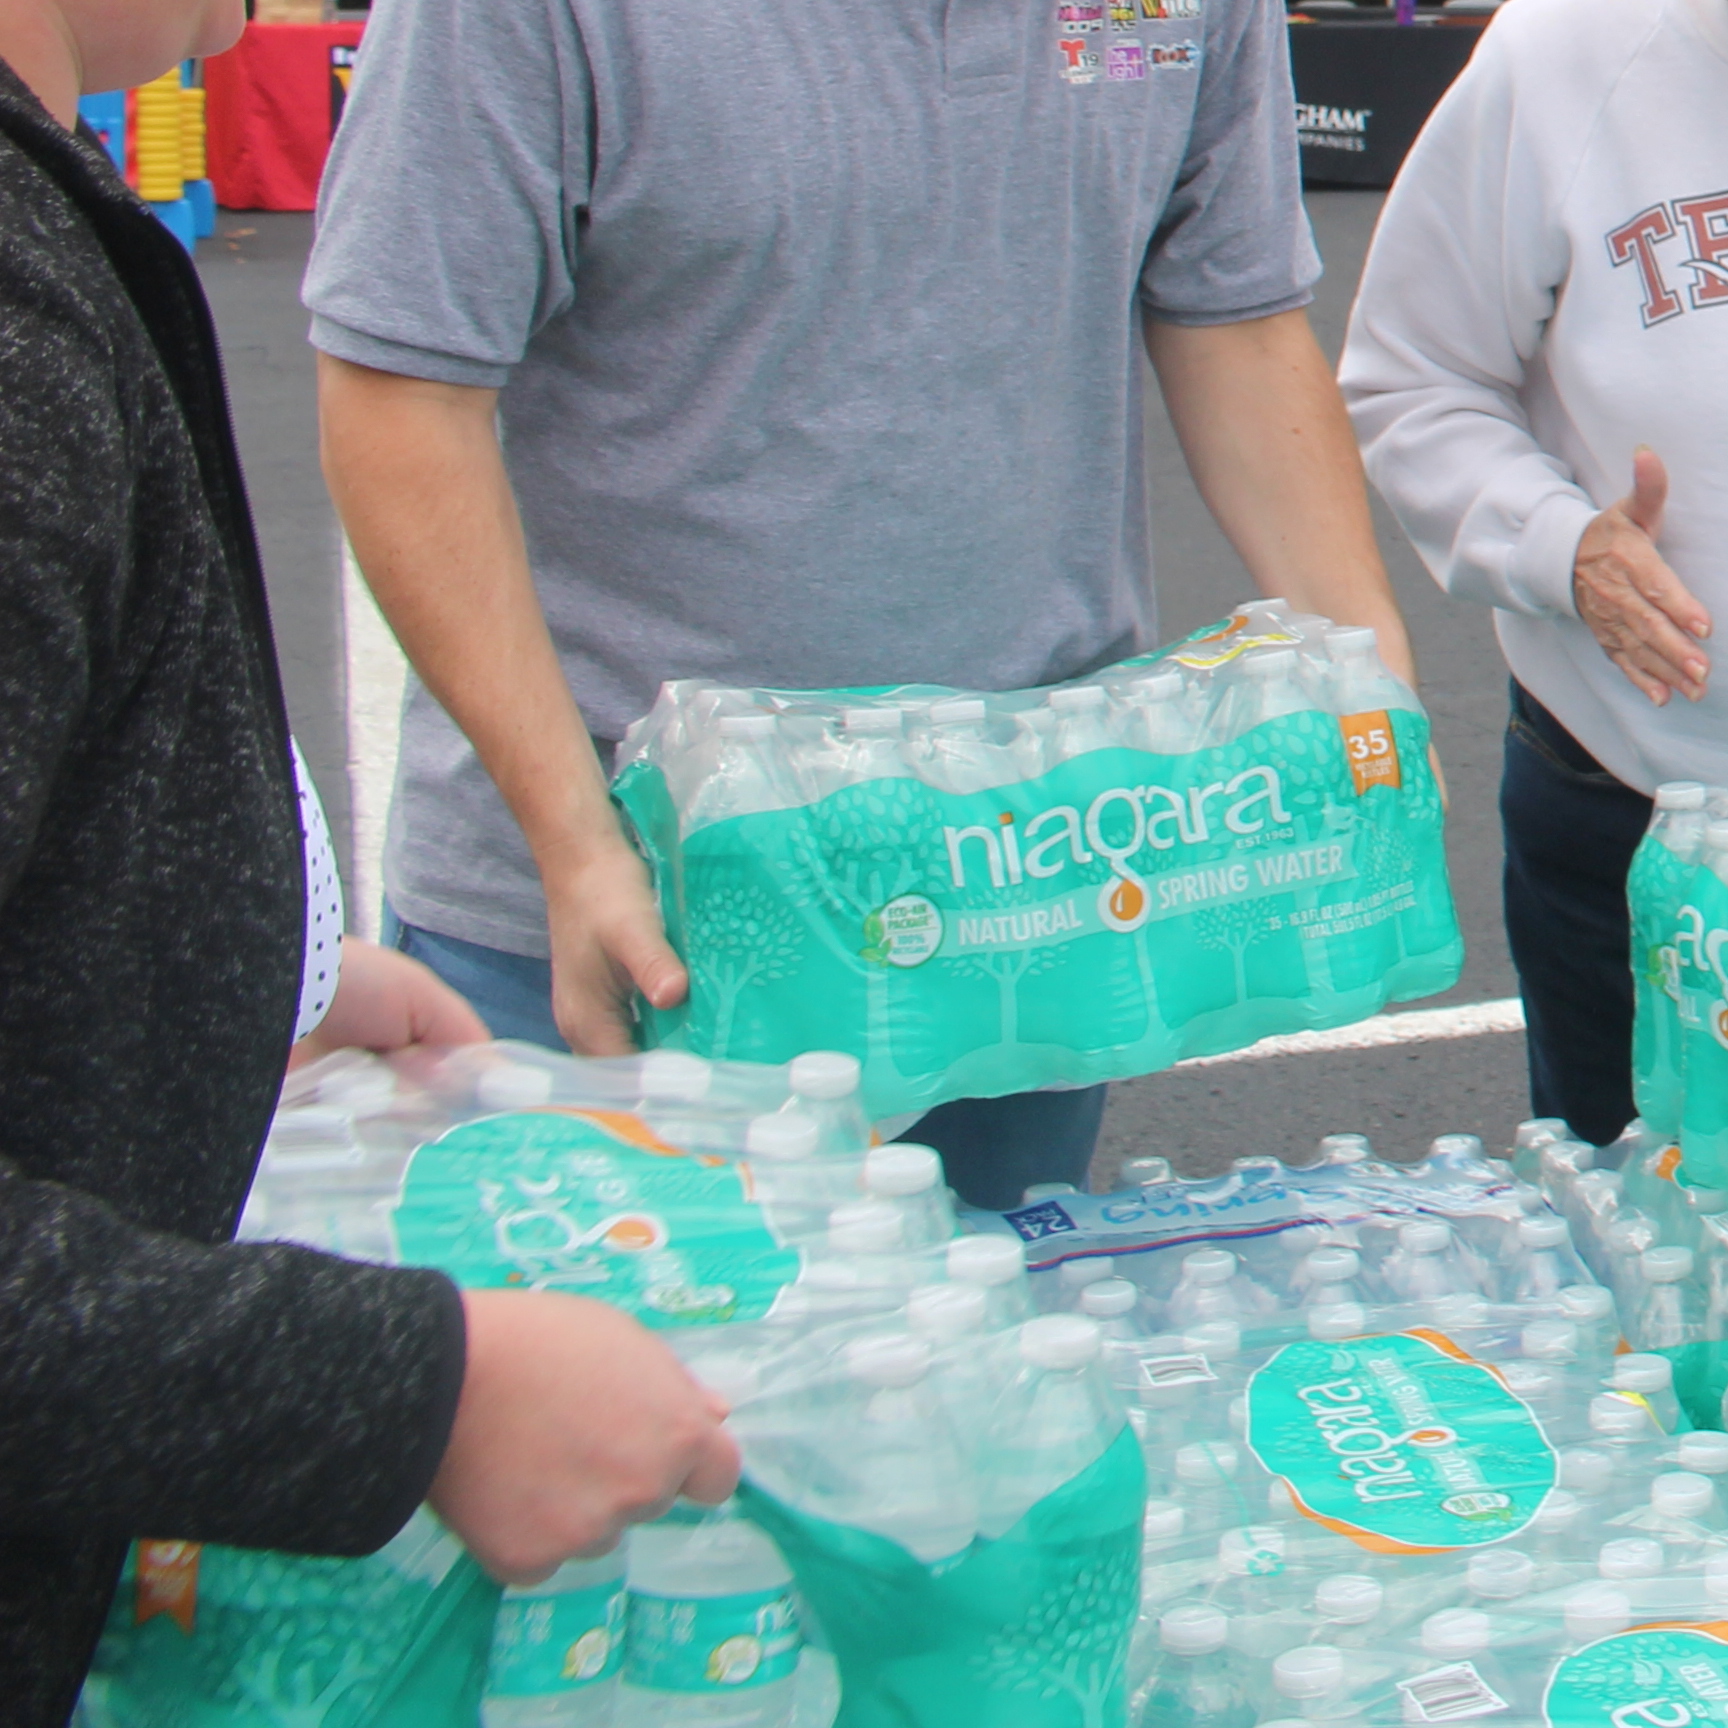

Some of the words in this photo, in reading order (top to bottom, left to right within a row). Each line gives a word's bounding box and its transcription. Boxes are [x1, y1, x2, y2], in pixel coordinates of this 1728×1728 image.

[1349, 729, 1389, 760] 35
[942, 764, 1292, 892] niagara
[957, 898, 1084, 948] NATURAL
[1157, 861, 1250, 910] SPRING
[1254, 844, 1345, 887] WATER
[1020, 1215, 1071, 1240] 24
[1297, 1378, 1425, 1504] niagara
